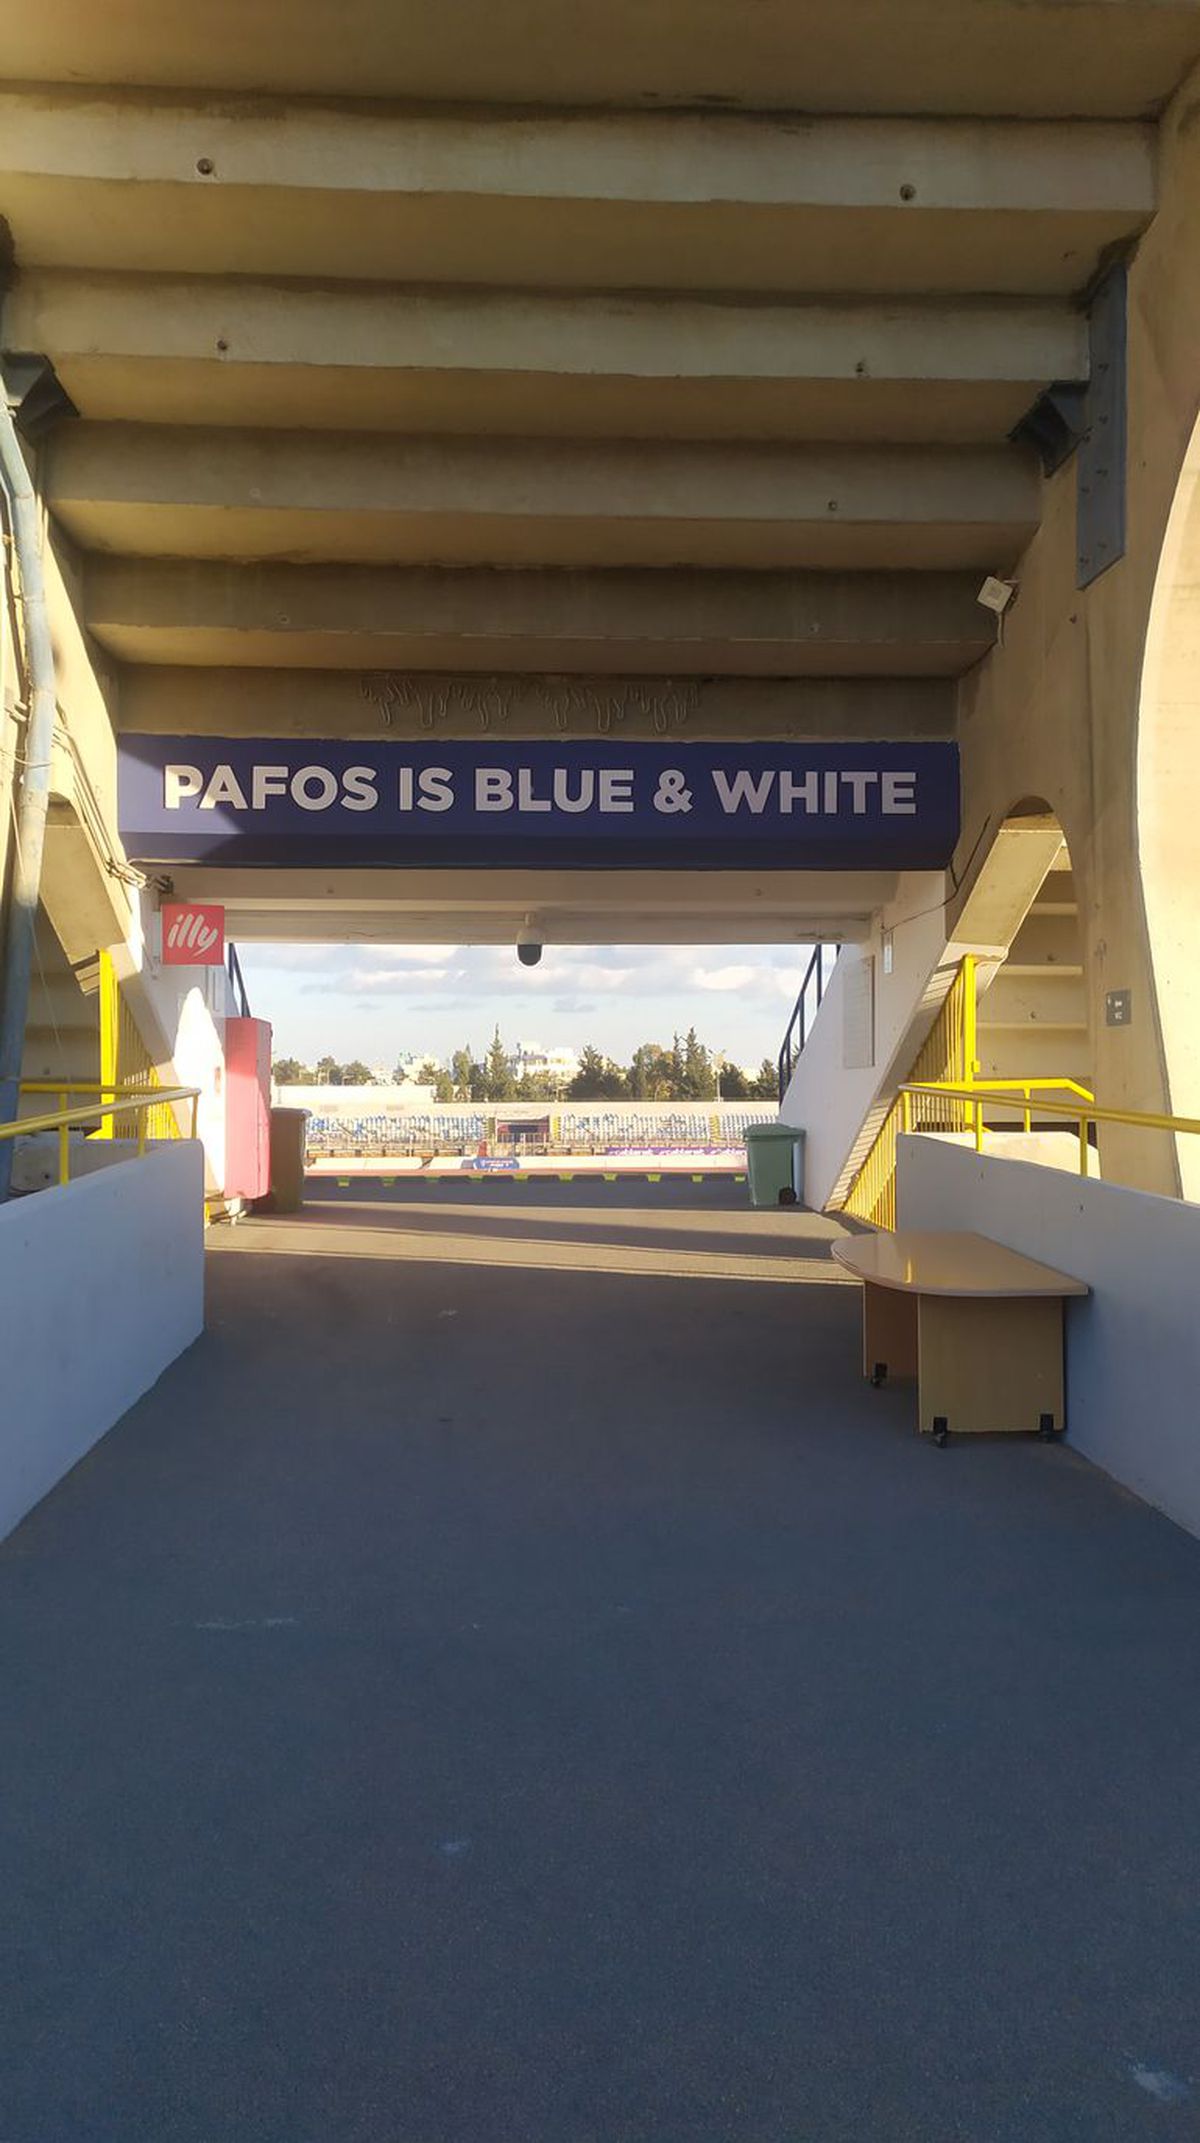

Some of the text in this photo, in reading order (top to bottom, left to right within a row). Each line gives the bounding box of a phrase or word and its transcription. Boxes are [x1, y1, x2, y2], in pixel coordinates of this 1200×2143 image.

[163, 764, 917, 814] PAFOS IS BLUE & WHITE
[167, 913, 219, 957] illy
